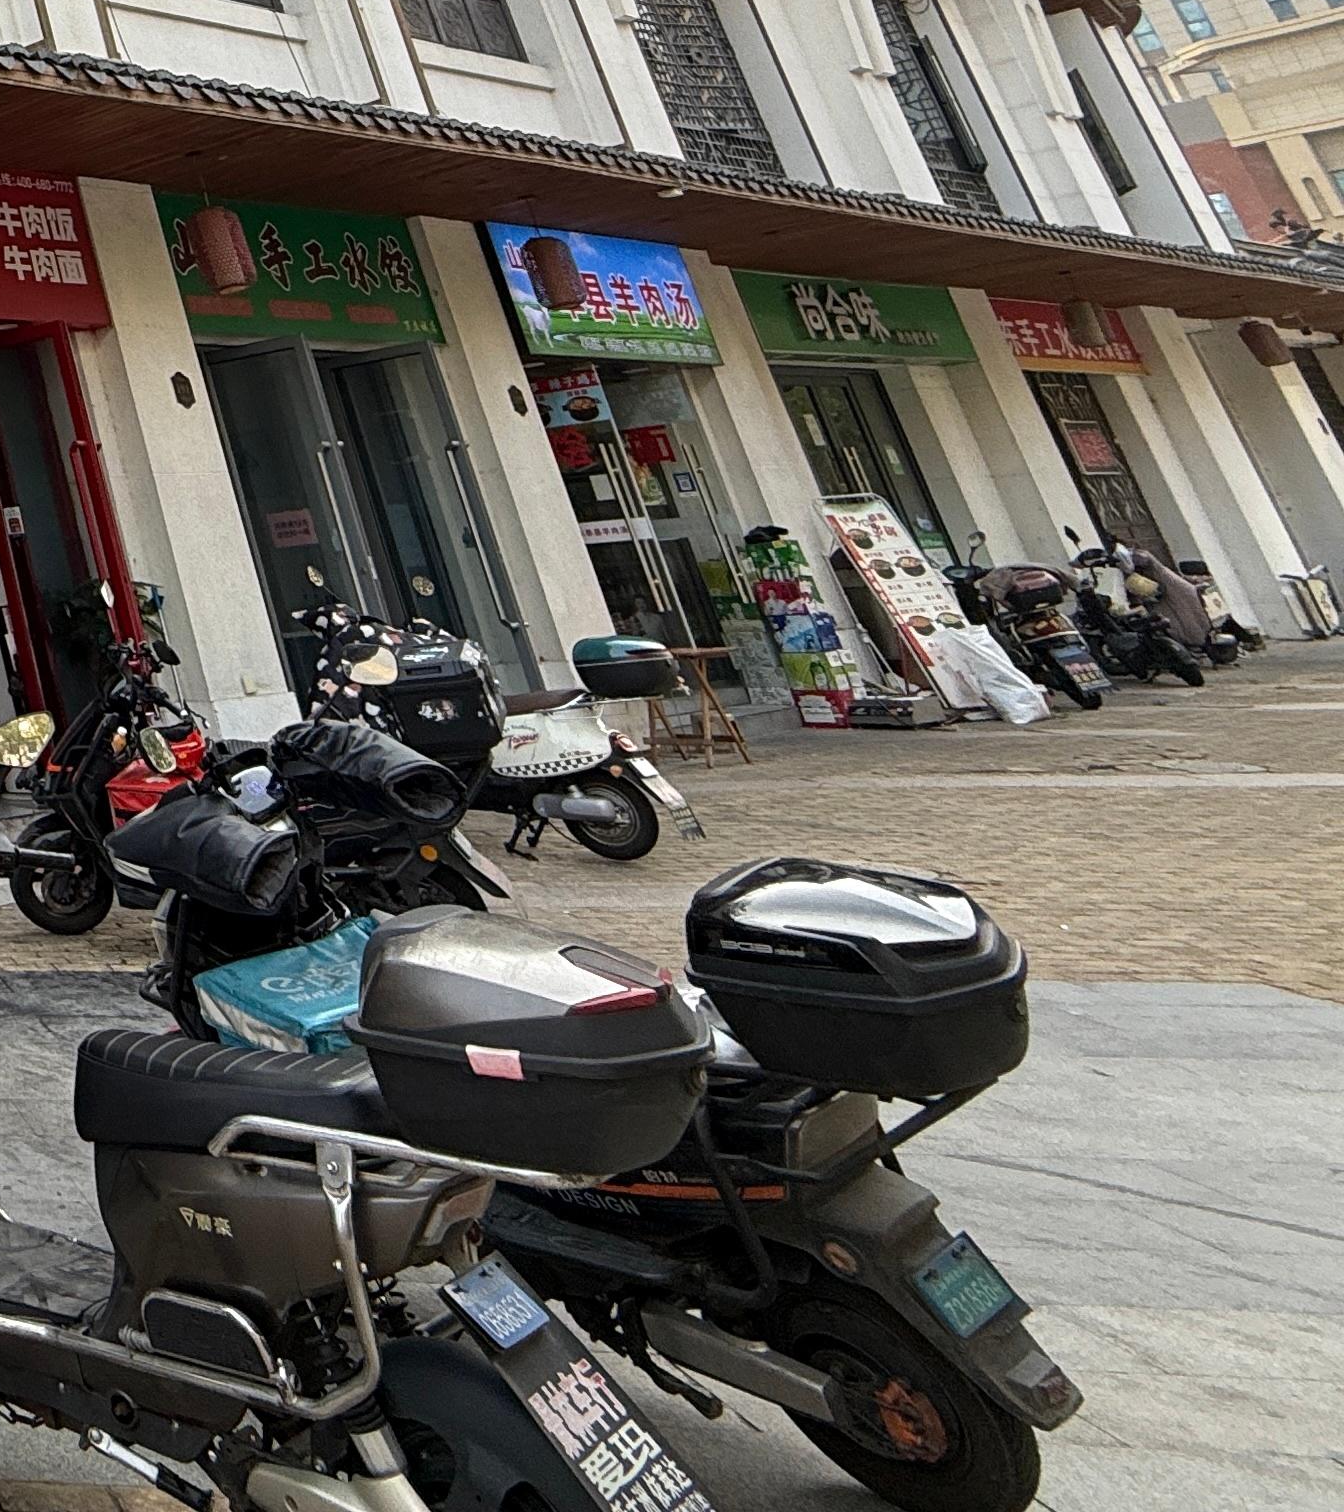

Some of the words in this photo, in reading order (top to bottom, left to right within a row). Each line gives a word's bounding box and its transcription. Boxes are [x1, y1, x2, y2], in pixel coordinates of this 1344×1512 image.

[3, 245, 89, 285] 牛肉面
[579, 1419, 662, 1501] 爱玛
